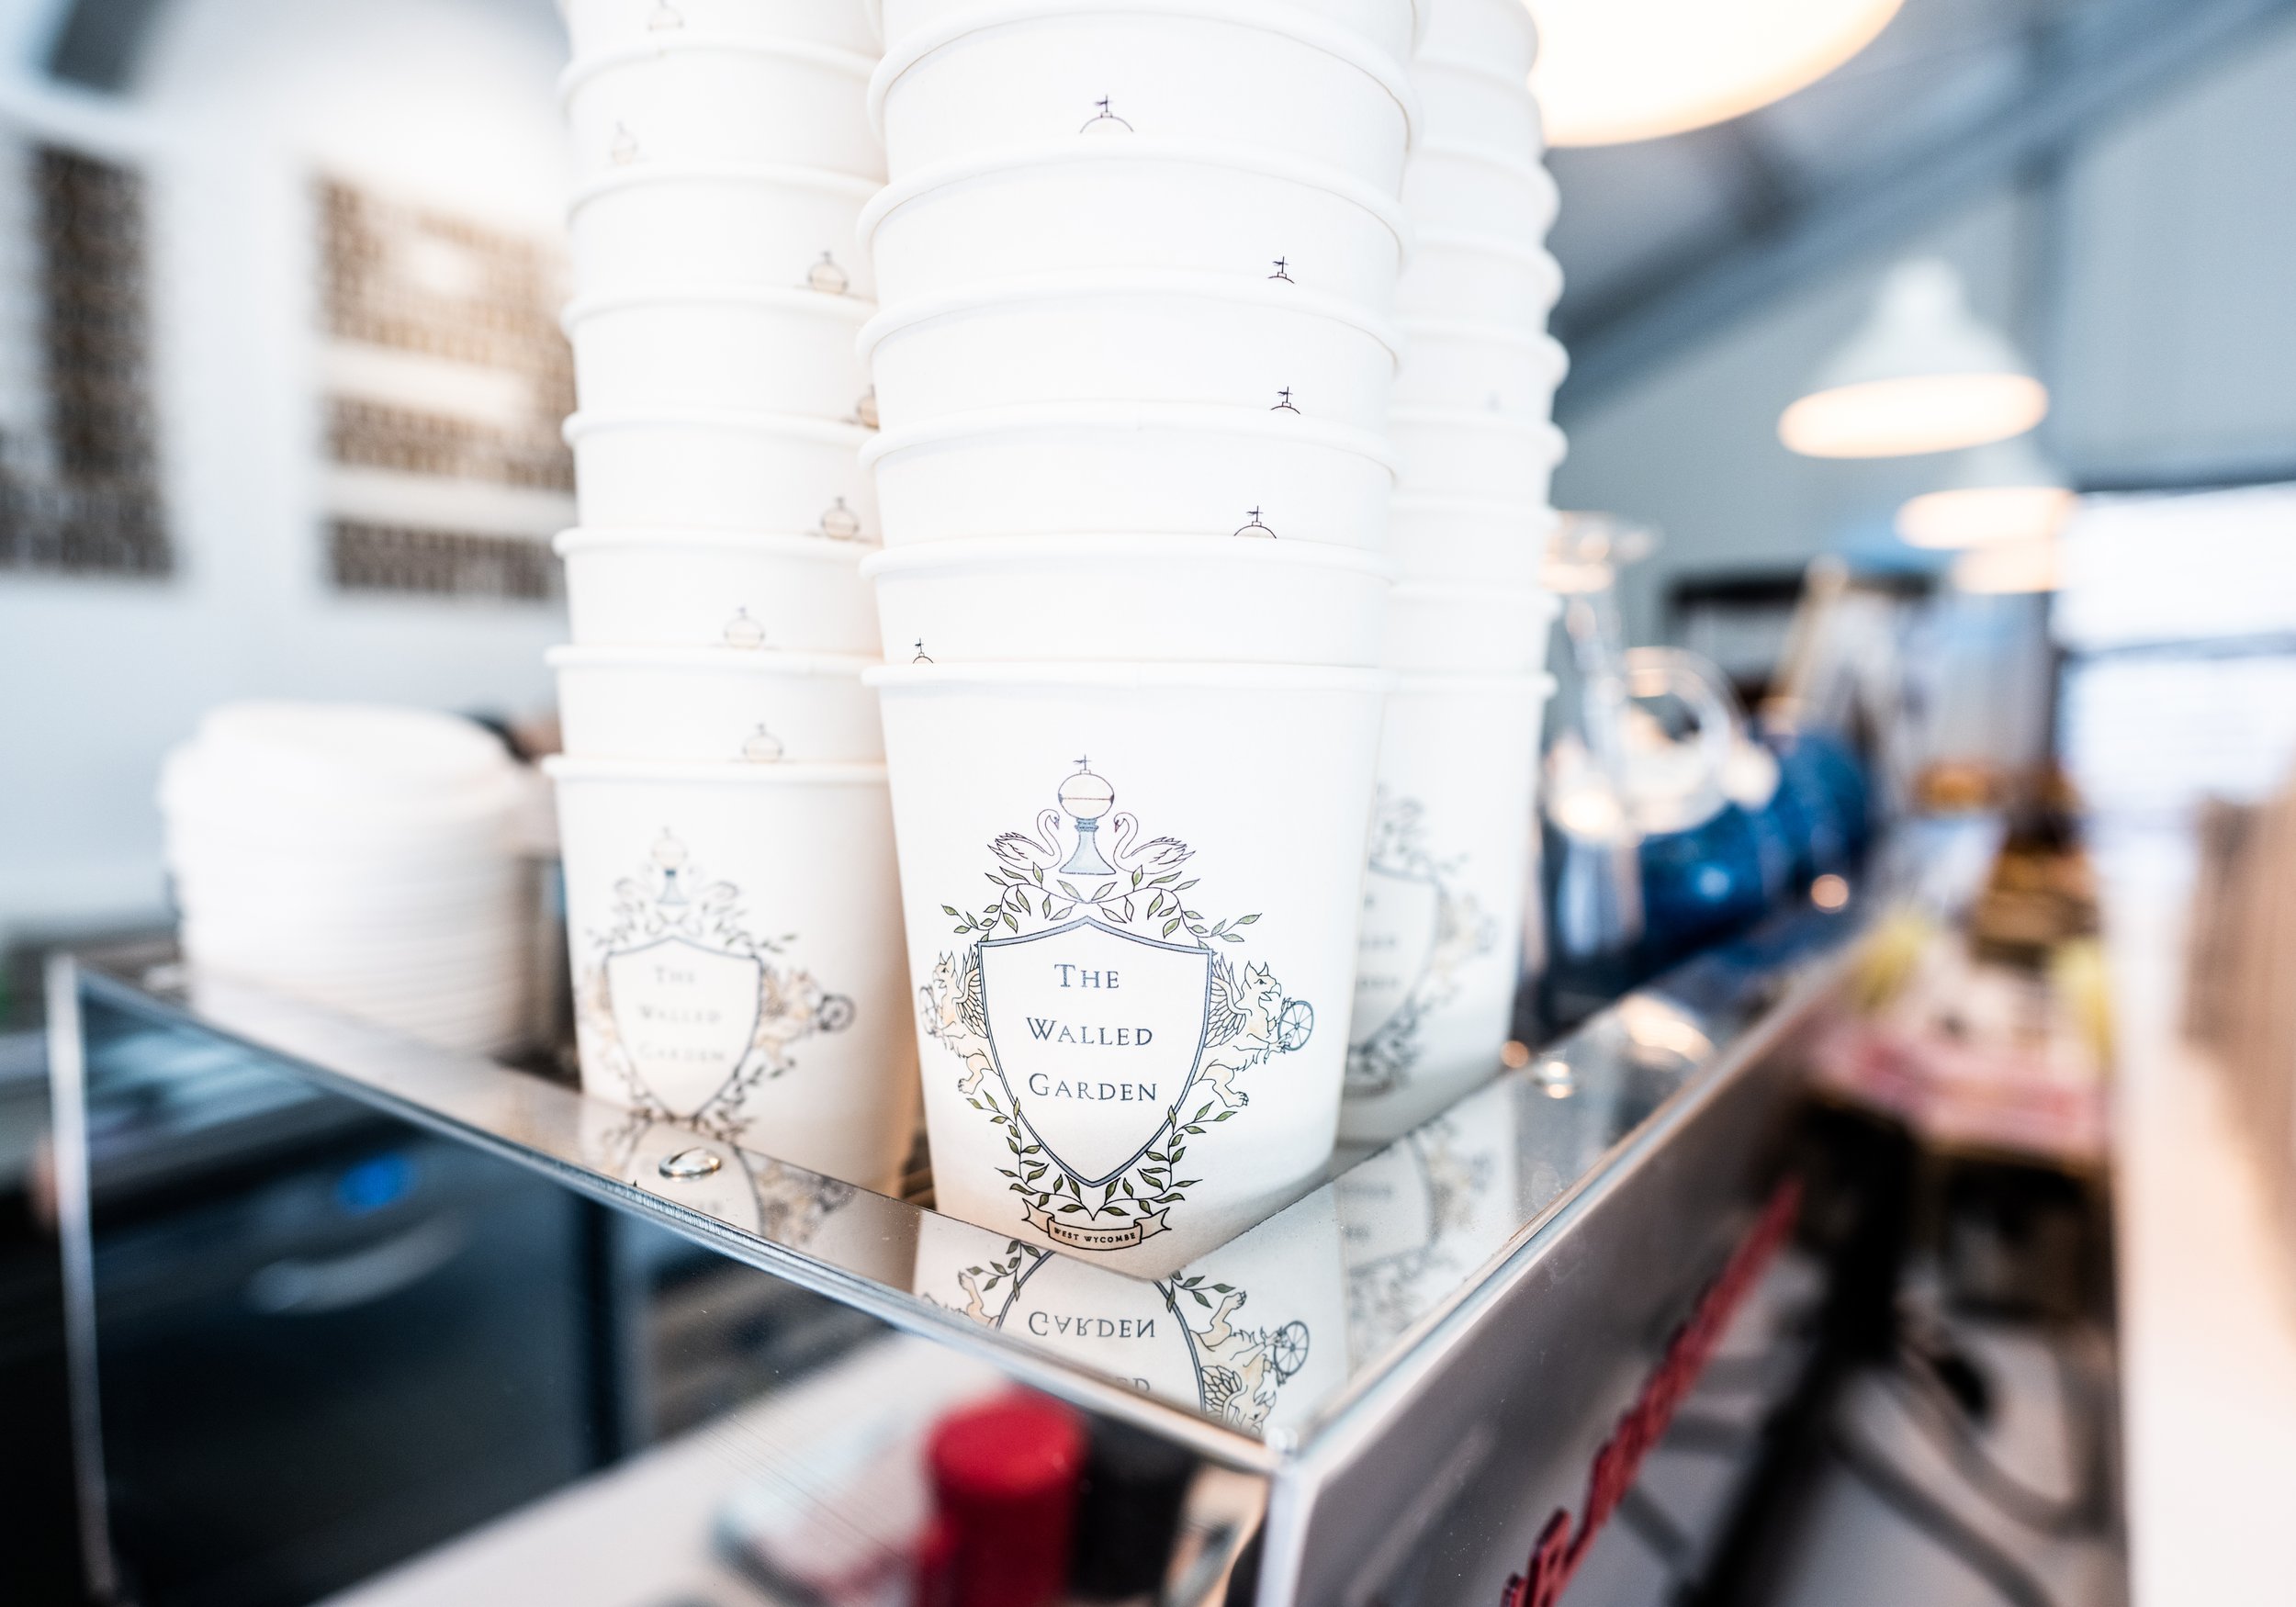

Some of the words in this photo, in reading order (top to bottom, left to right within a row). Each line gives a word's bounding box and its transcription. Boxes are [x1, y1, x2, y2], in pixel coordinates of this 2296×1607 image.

[1053, 963, 1120, 989] THE
[1025, 1017, 1154, 1047] WALLED
[1028, 1073, 1157, 1102] GARDEN
[1053, 1227, 1079, 1241] WEST
[1084, 1232, 1136, 1243] WYCOMBE
